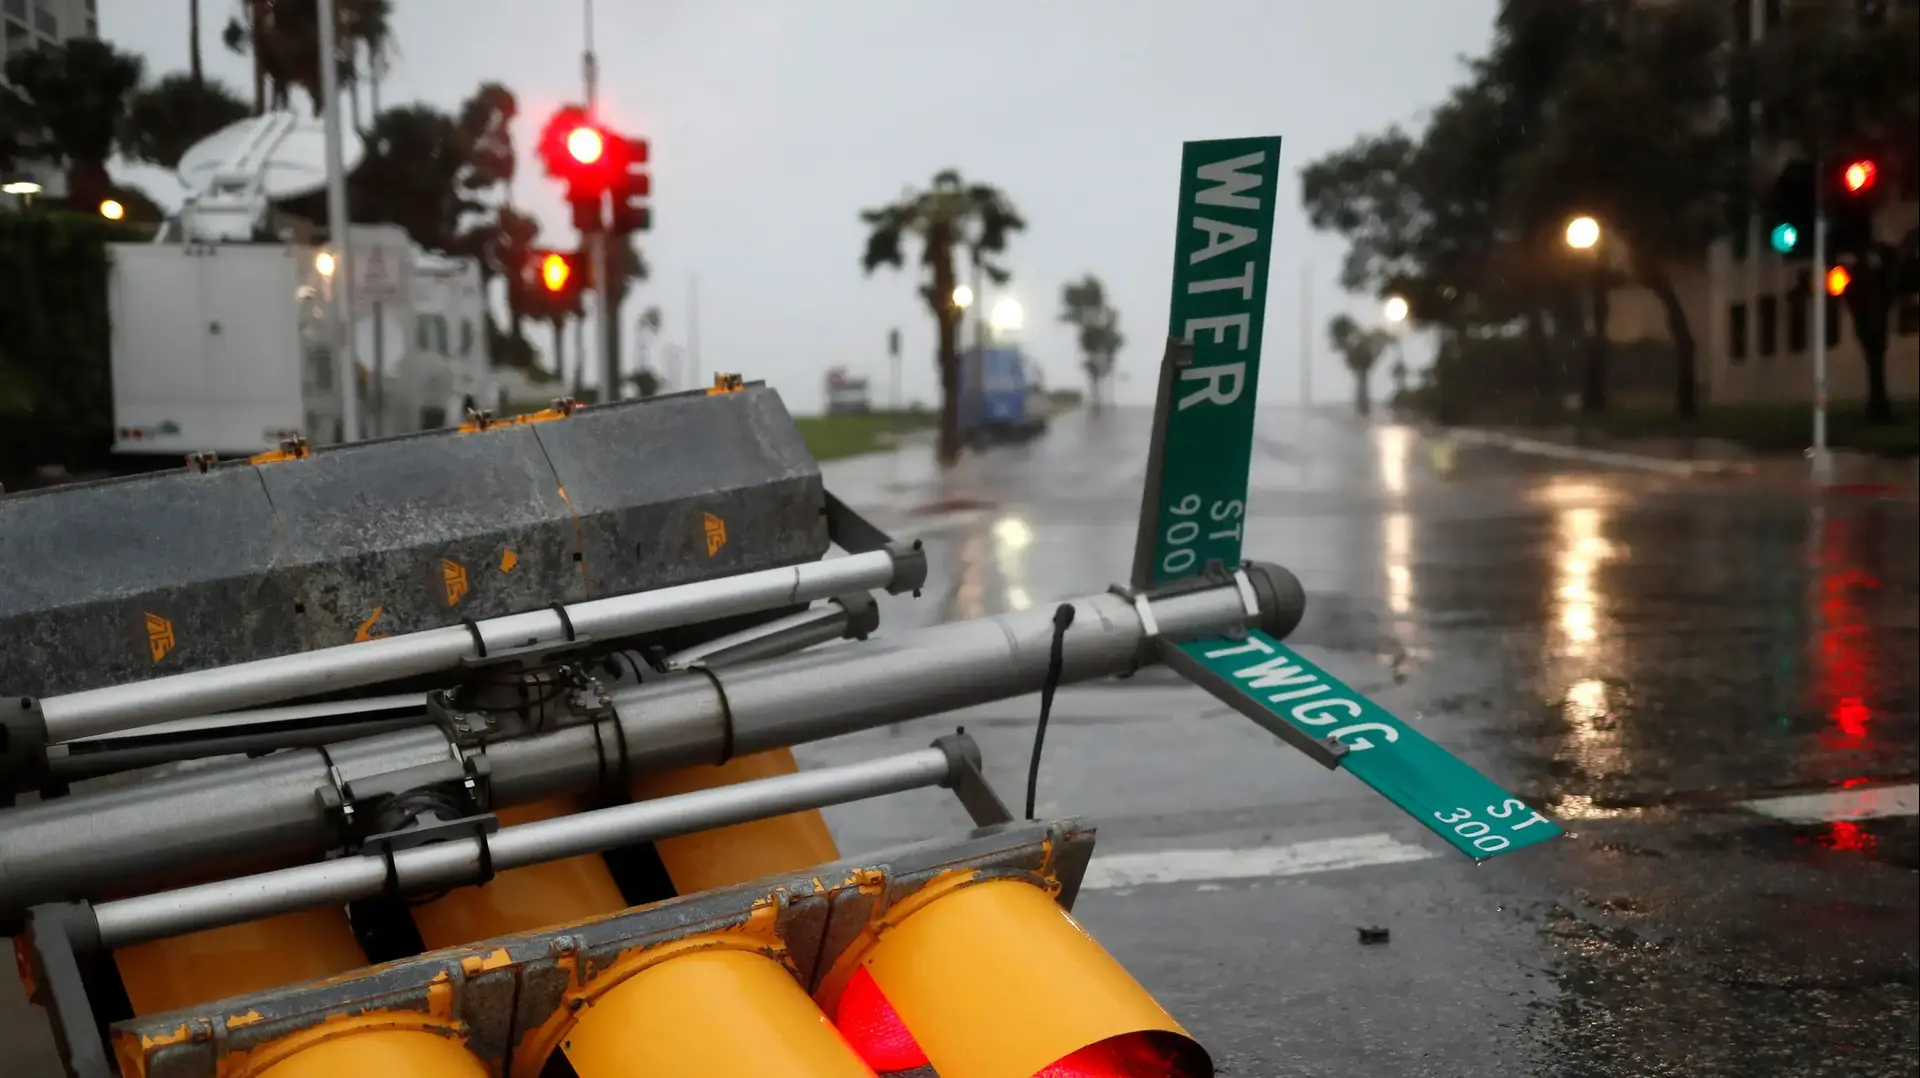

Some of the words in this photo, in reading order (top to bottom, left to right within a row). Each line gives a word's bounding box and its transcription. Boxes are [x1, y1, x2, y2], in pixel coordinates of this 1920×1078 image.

[1179, 151, 1265, 411] WATER
[1163, 494, 1200, 573] 900
[1209, 500, 1243, 541] ST
[1205, 637, 1398, 751] TWIGG
[1487, 799, 1549, 831] ST
[1435, 807, 1510, 852] 300
